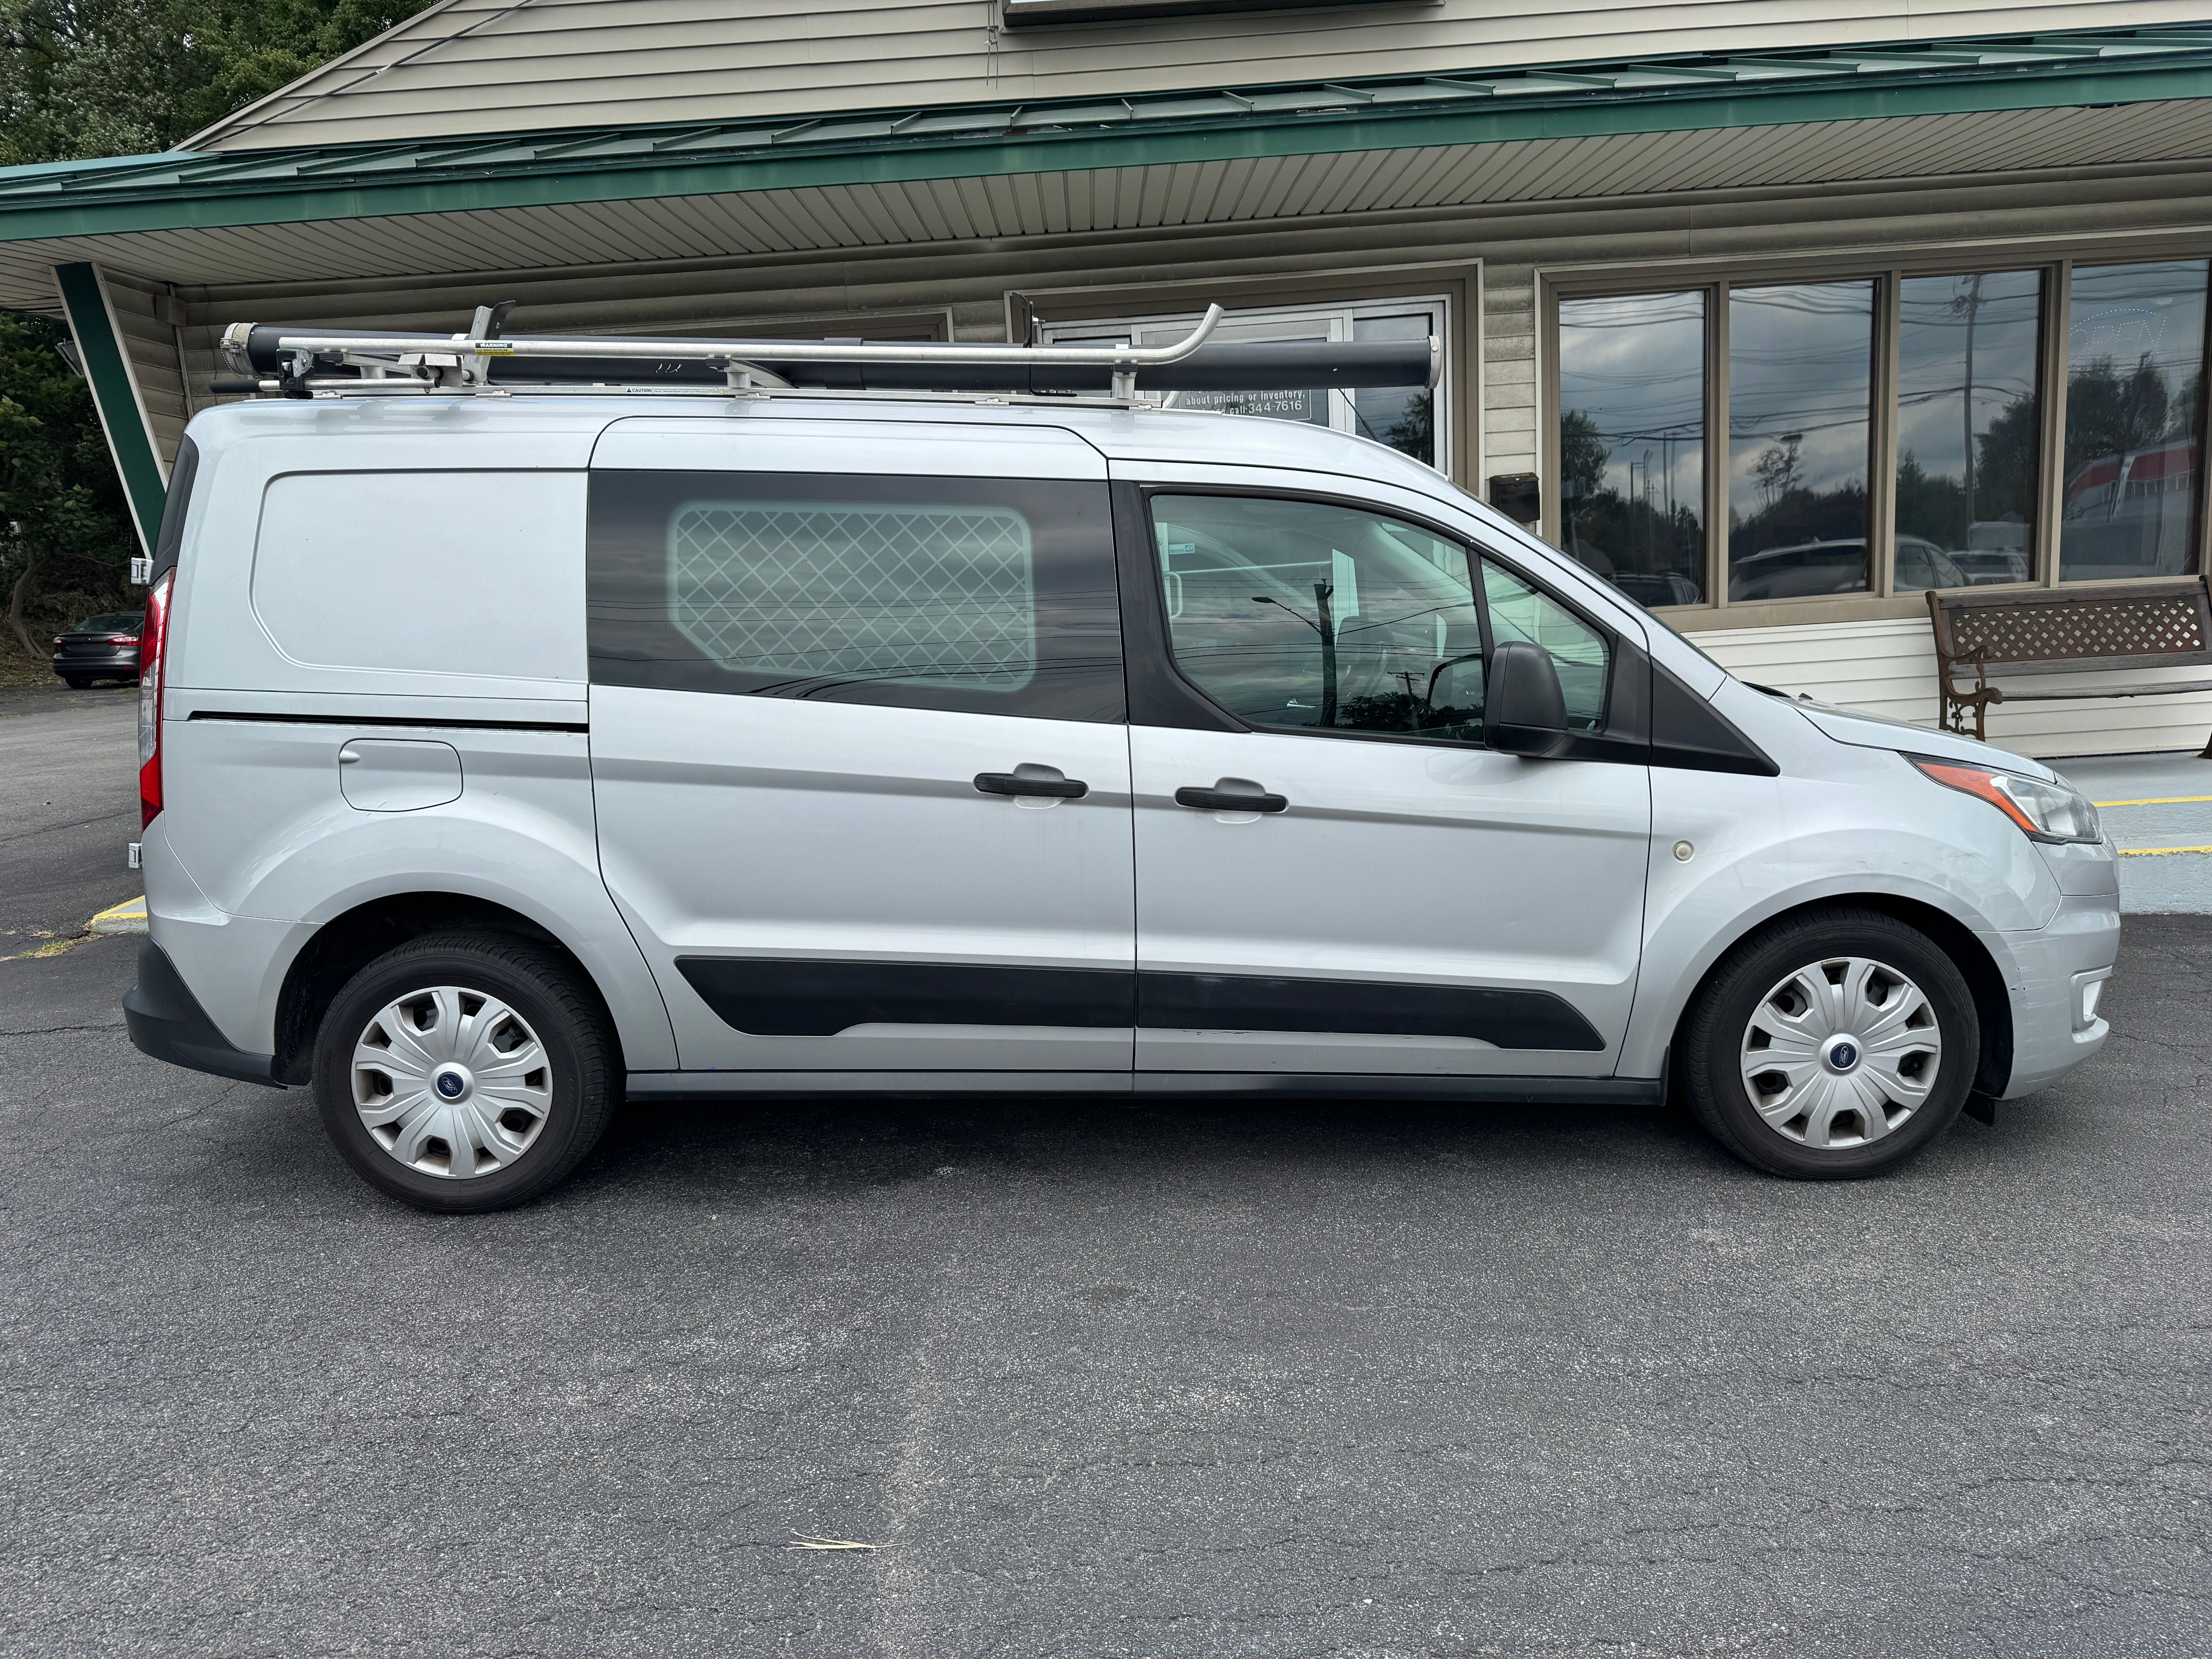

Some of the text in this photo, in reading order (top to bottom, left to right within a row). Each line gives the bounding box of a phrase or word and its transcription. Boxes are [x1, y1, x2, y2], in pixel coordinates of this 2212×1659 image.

[1186, 396, 1210, 405] about
[1214, 393, 1243, 405] pricing
[1261, 390, 1305, 401] inventory,
[1249, 400, 1302, 414] 344-7616
